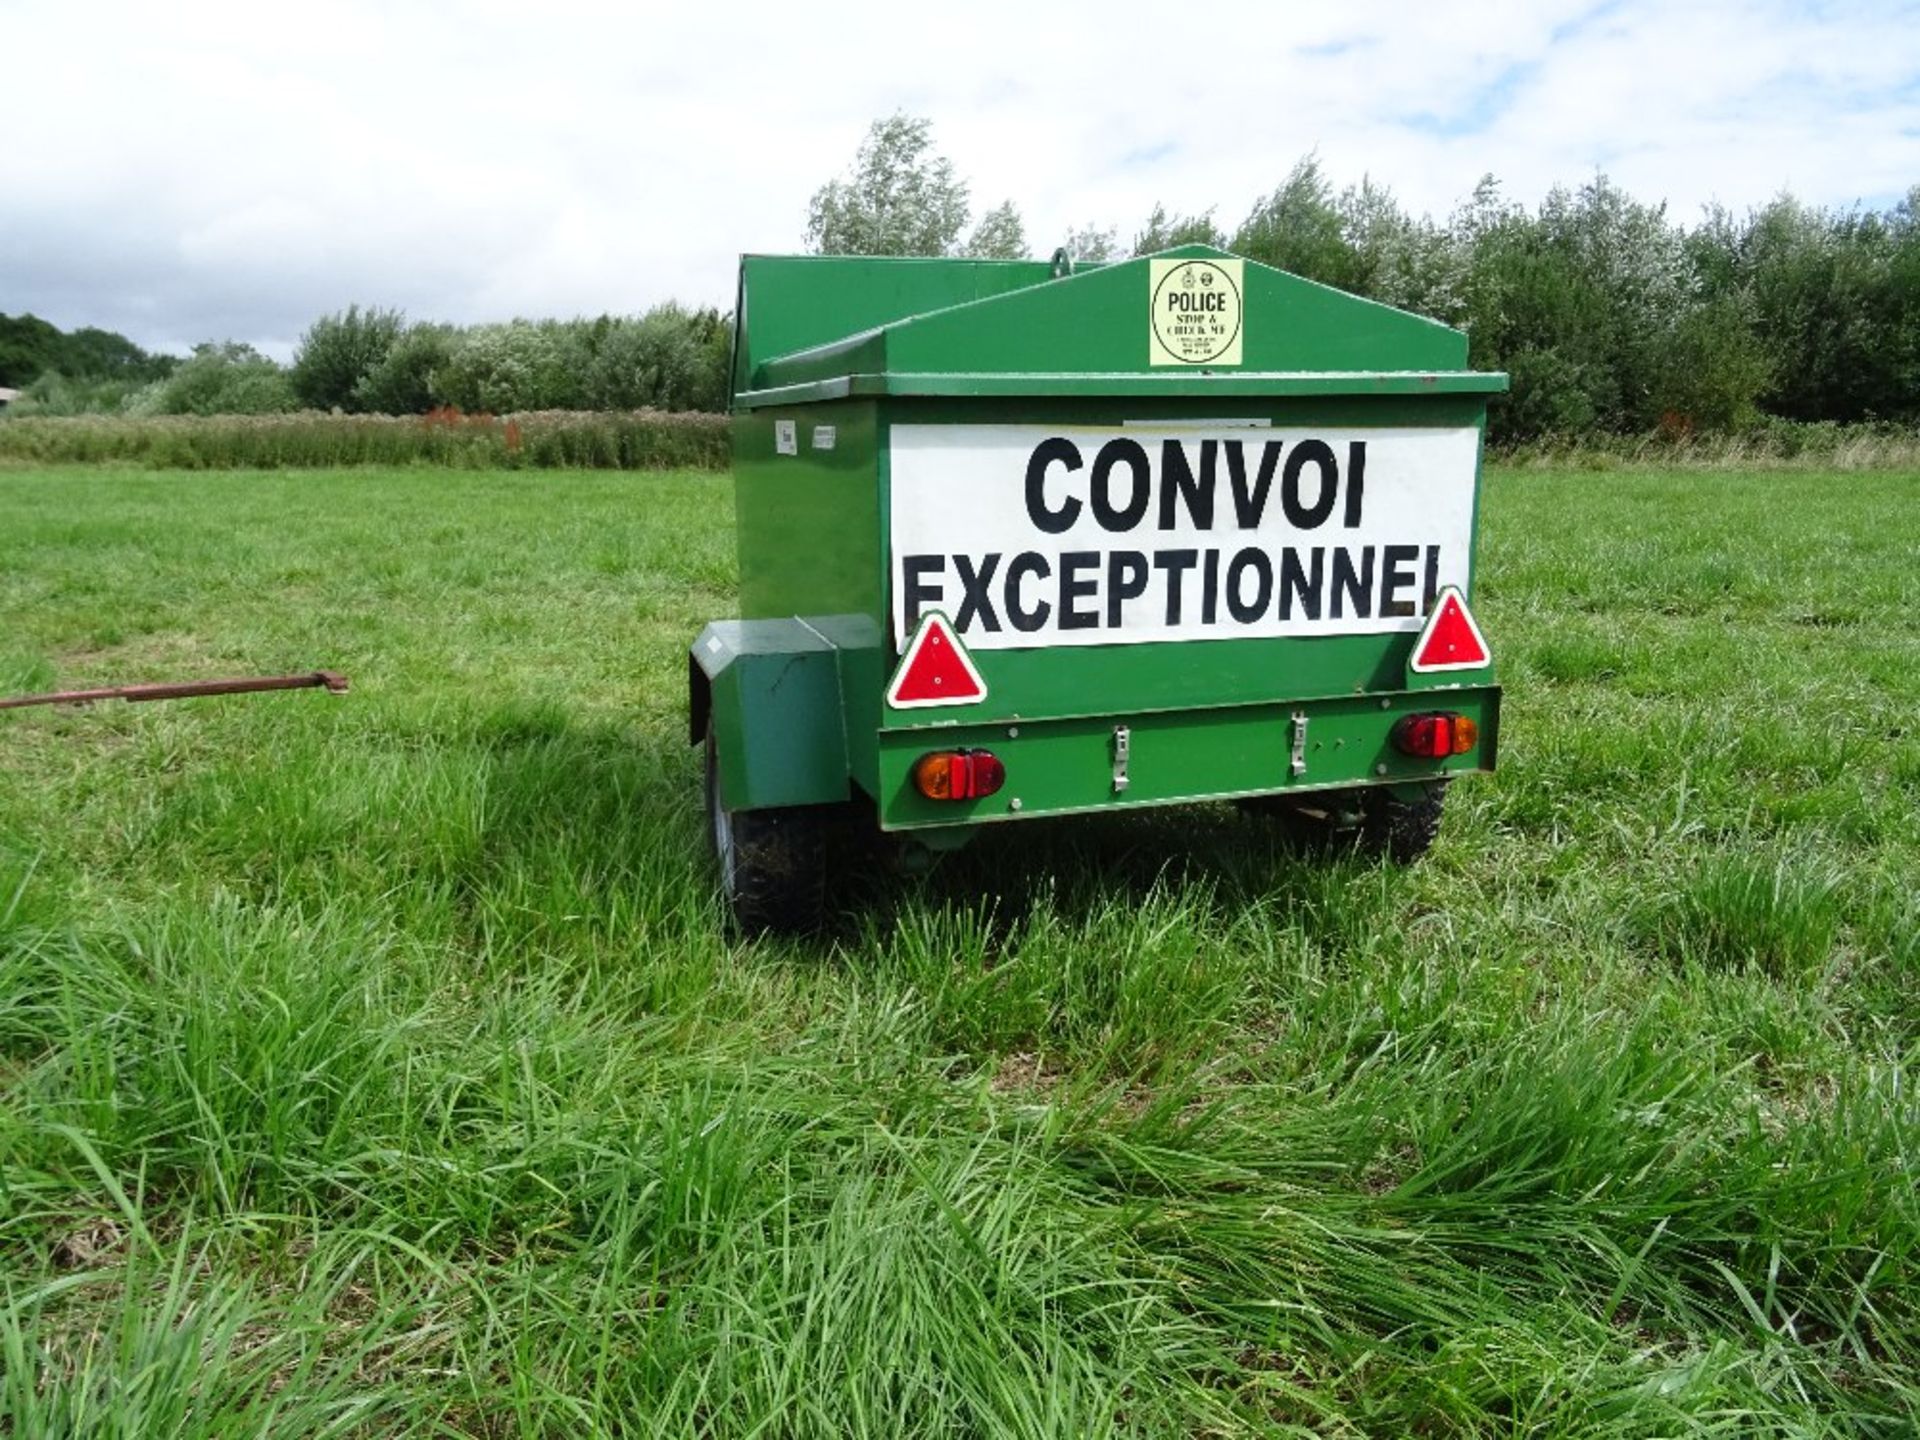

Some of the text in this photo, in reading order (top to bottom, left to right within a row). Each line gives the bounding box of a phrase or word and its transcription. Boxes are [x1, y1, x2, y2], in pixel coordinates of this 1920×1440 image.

[1169, 292, 1226, 312] POLICE
[1176, 314, 1205, 324] STOP
[1024, 437, 1367, 534] CONVOI
